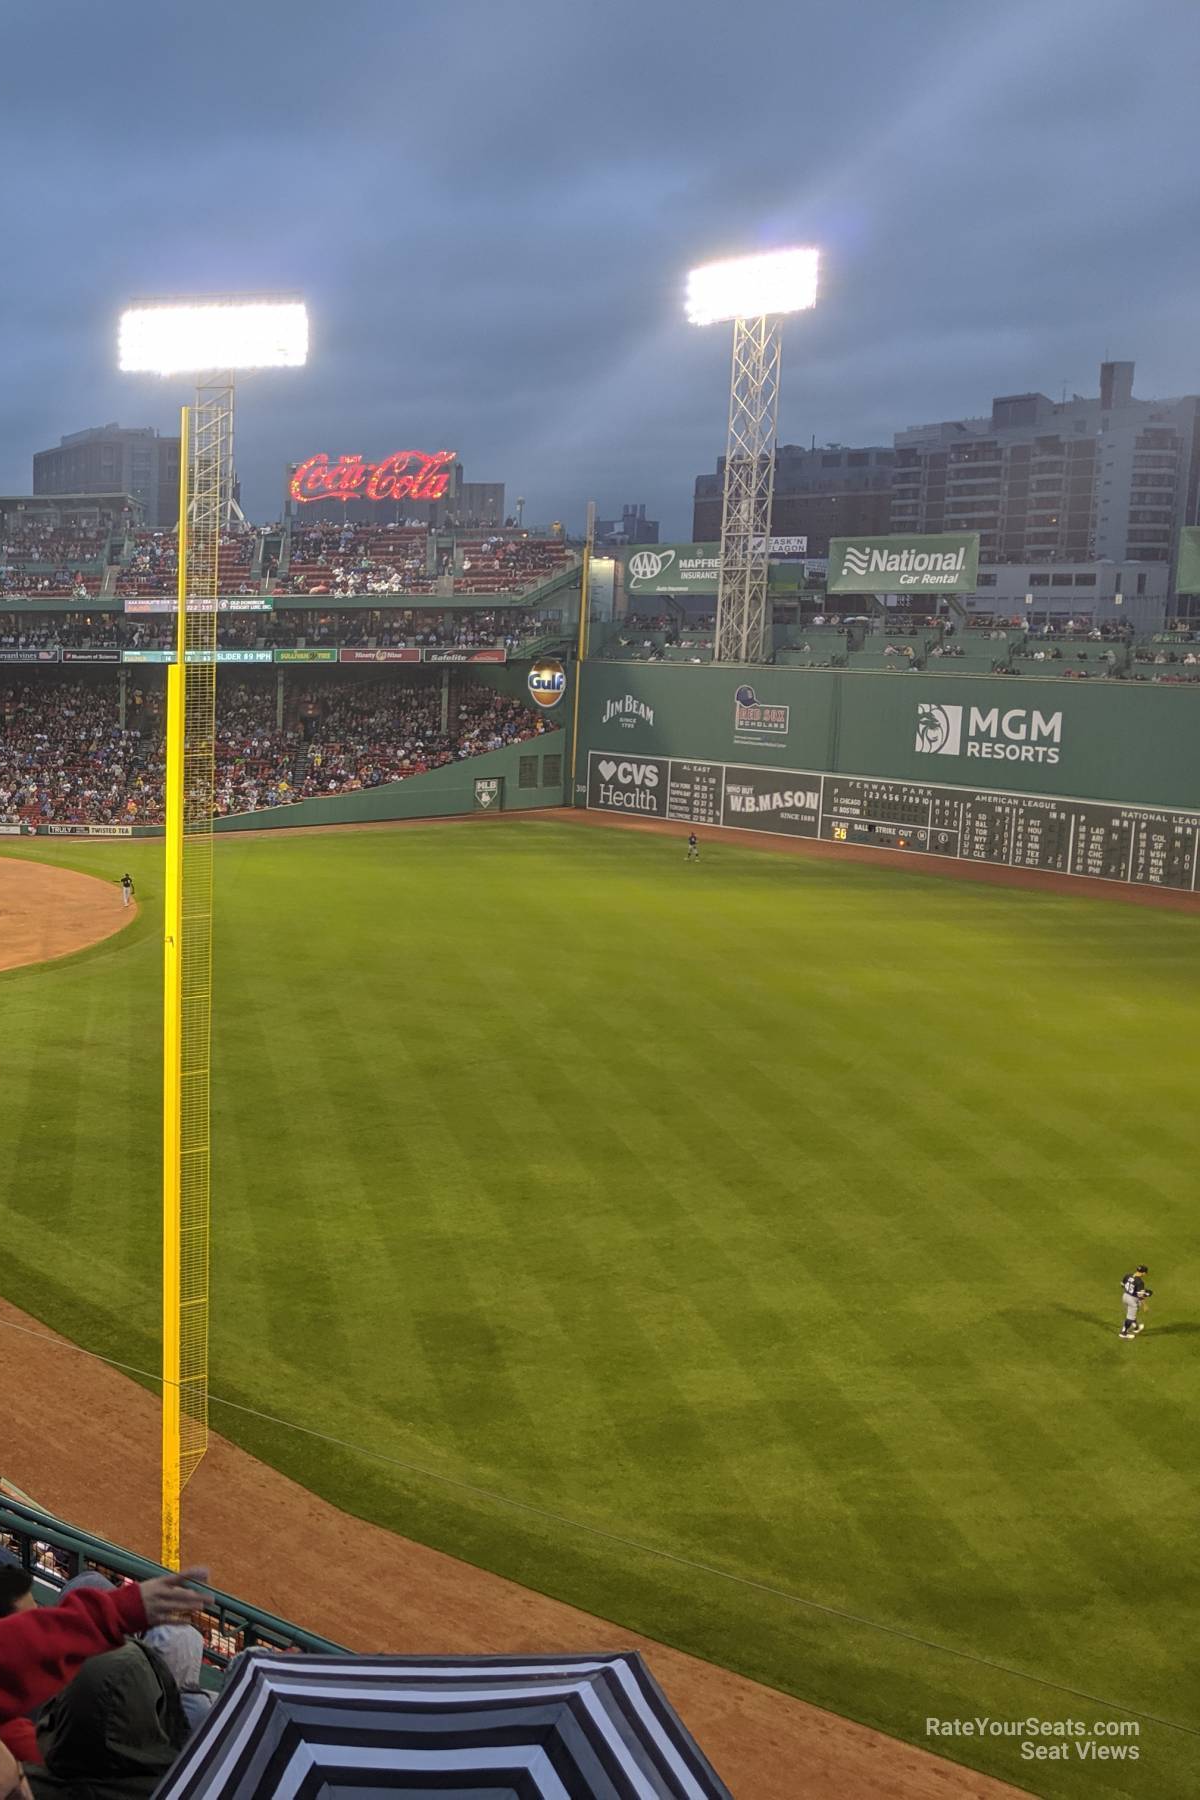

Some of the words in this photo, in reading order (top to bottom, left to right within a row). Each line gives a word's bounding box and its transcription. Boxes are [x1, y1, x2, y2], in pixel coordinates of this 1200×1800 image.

[289, 451, 456, 502] Coca-Cola
[634, 554, 657, 574] AAA
[679, 559, 720, 568] MAPFRE
[869, 547, 965, 572] National
[680, 571, 718, 579] INSURANCE
[899, 574, 919, 584] Car
[921, 573, 959, 584] Rental
[256, 653, 271, 661] MPH
[529, 673, 563, 689] Gulf
[603, 699, 623, 723] JIM
[624, 695, 654, 727] BEAM
[764, 709, 785, 722] SOX
[968, 707, 1063, 743] MGM
[967, 742, 1060, 764] RESORTS
[618, 762, 659, 787] CVS
[477, 781, 497, 789] MLB
[726, 785, 741, 793] WHO
[742, 786, 753, 795] BUT
[849, 782, 893, 792] FENWAY
[903, 787, 932, 796] PARK
[599, 784, 658, 811] Health
[730, 791, 818, 812] W.B.MASON
[840, 798, 861, 806] CHICAGO
[975, 795, 1019, 805] AMERICAN
[1023, 801, 1057, 810] LEAGUE
[780, 812, 800, 820] SINCE
[839, 806, 860, 815] BOSTON
[975, 820, 987, 828] BAL
[1030, 819, 1040, 827] PIT
[1121, 811, 1167, 822] NATIONAL
[1173, 816, 1200, 826] LEAG
[52, 826, 71, 834] TRULY
[118, 827, 130, 835] TEA
[854, 824, 868, 832] BALL
[875, 826, 896, 836] STRIKE
[898, 829, 912, 837] OUT
[975, 828, 987, 836] TOR
[1030, 834, 1039, 842] TB
[1091, 827, 1104, 835] LAD
[1152, 834, 1166, 842] COL
[974, 835, 987, 843] NYY
[1028, 842, 1039, 850] MIN
[975, 843, 985, 851] KC
[973, 850, 986, 858] CLE
[1026, 857, 1039, 865] DET
[1090, 842, 1102, 851] ATL
[1150, 851, 1166, 859] WSH
[1088, 851, 1103, 859] CHC
[1150, 859, 1163, 867] MIA
[1088, 859, 1103, 867] NYM
[1150, 867, 1163, 875] SEA
[1088, 866, 1100, 874] PHI
[1150, 875, 1161, 883] MIL
